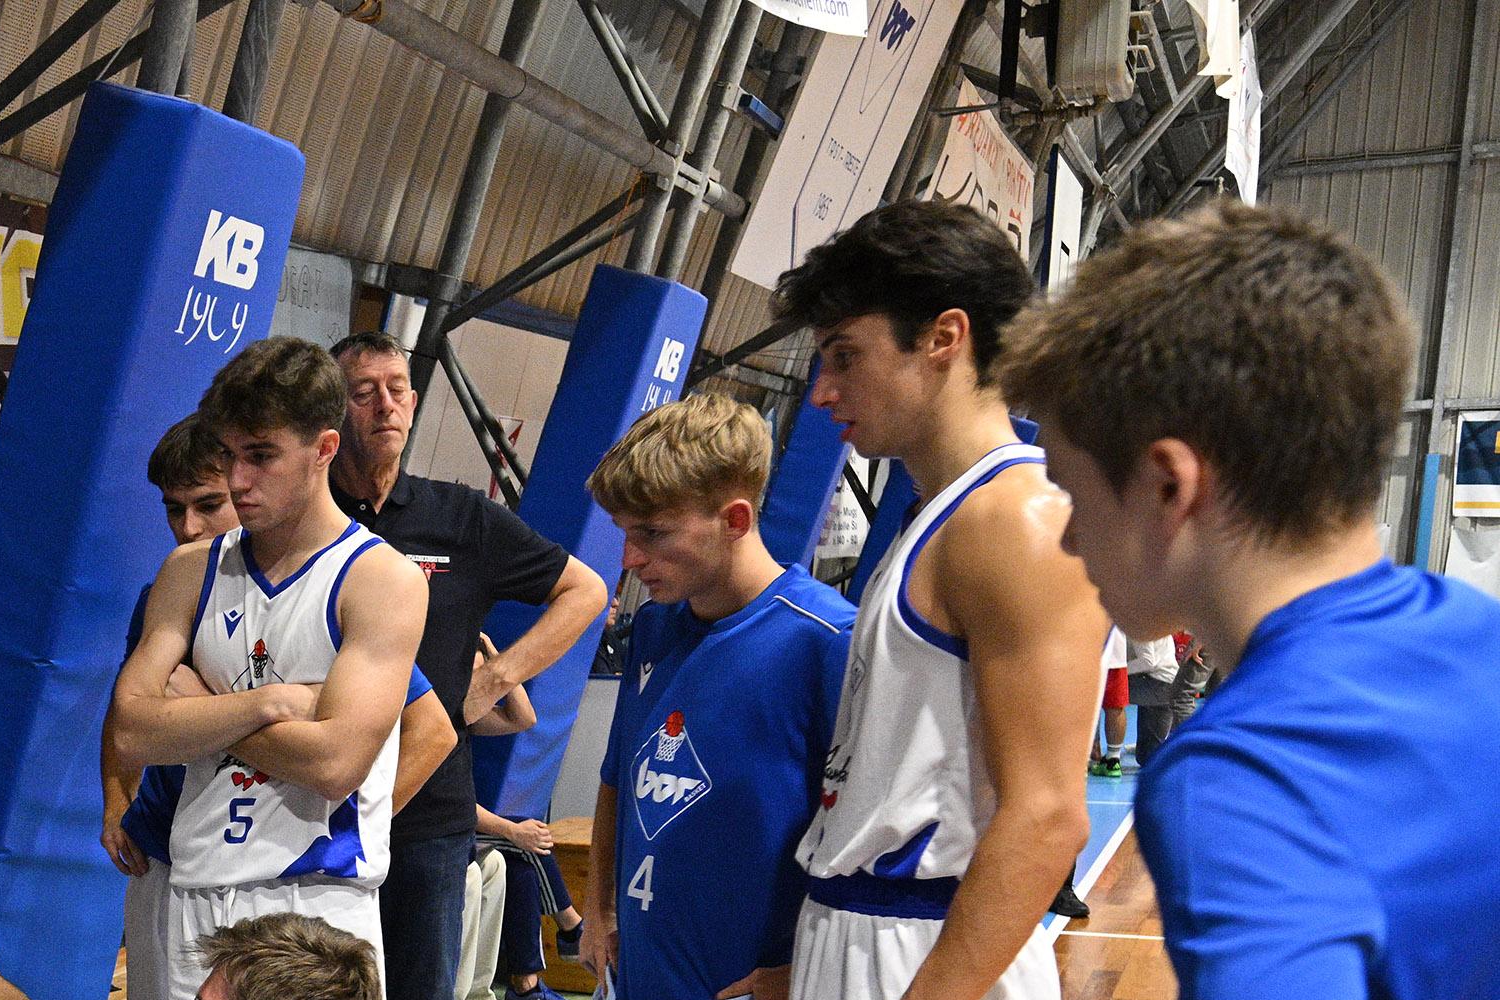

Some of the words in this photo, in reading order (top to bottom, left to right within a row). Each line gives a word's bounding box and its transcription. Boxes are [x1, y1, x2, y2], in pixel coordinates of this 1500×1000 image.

[193, 209, 265, 290] KB
[653, 336, 685, 383] KB
[636, 757, 702, 805] bor
[223, 797, 257, 844] 5
[627, 855, 655, 911] 4
